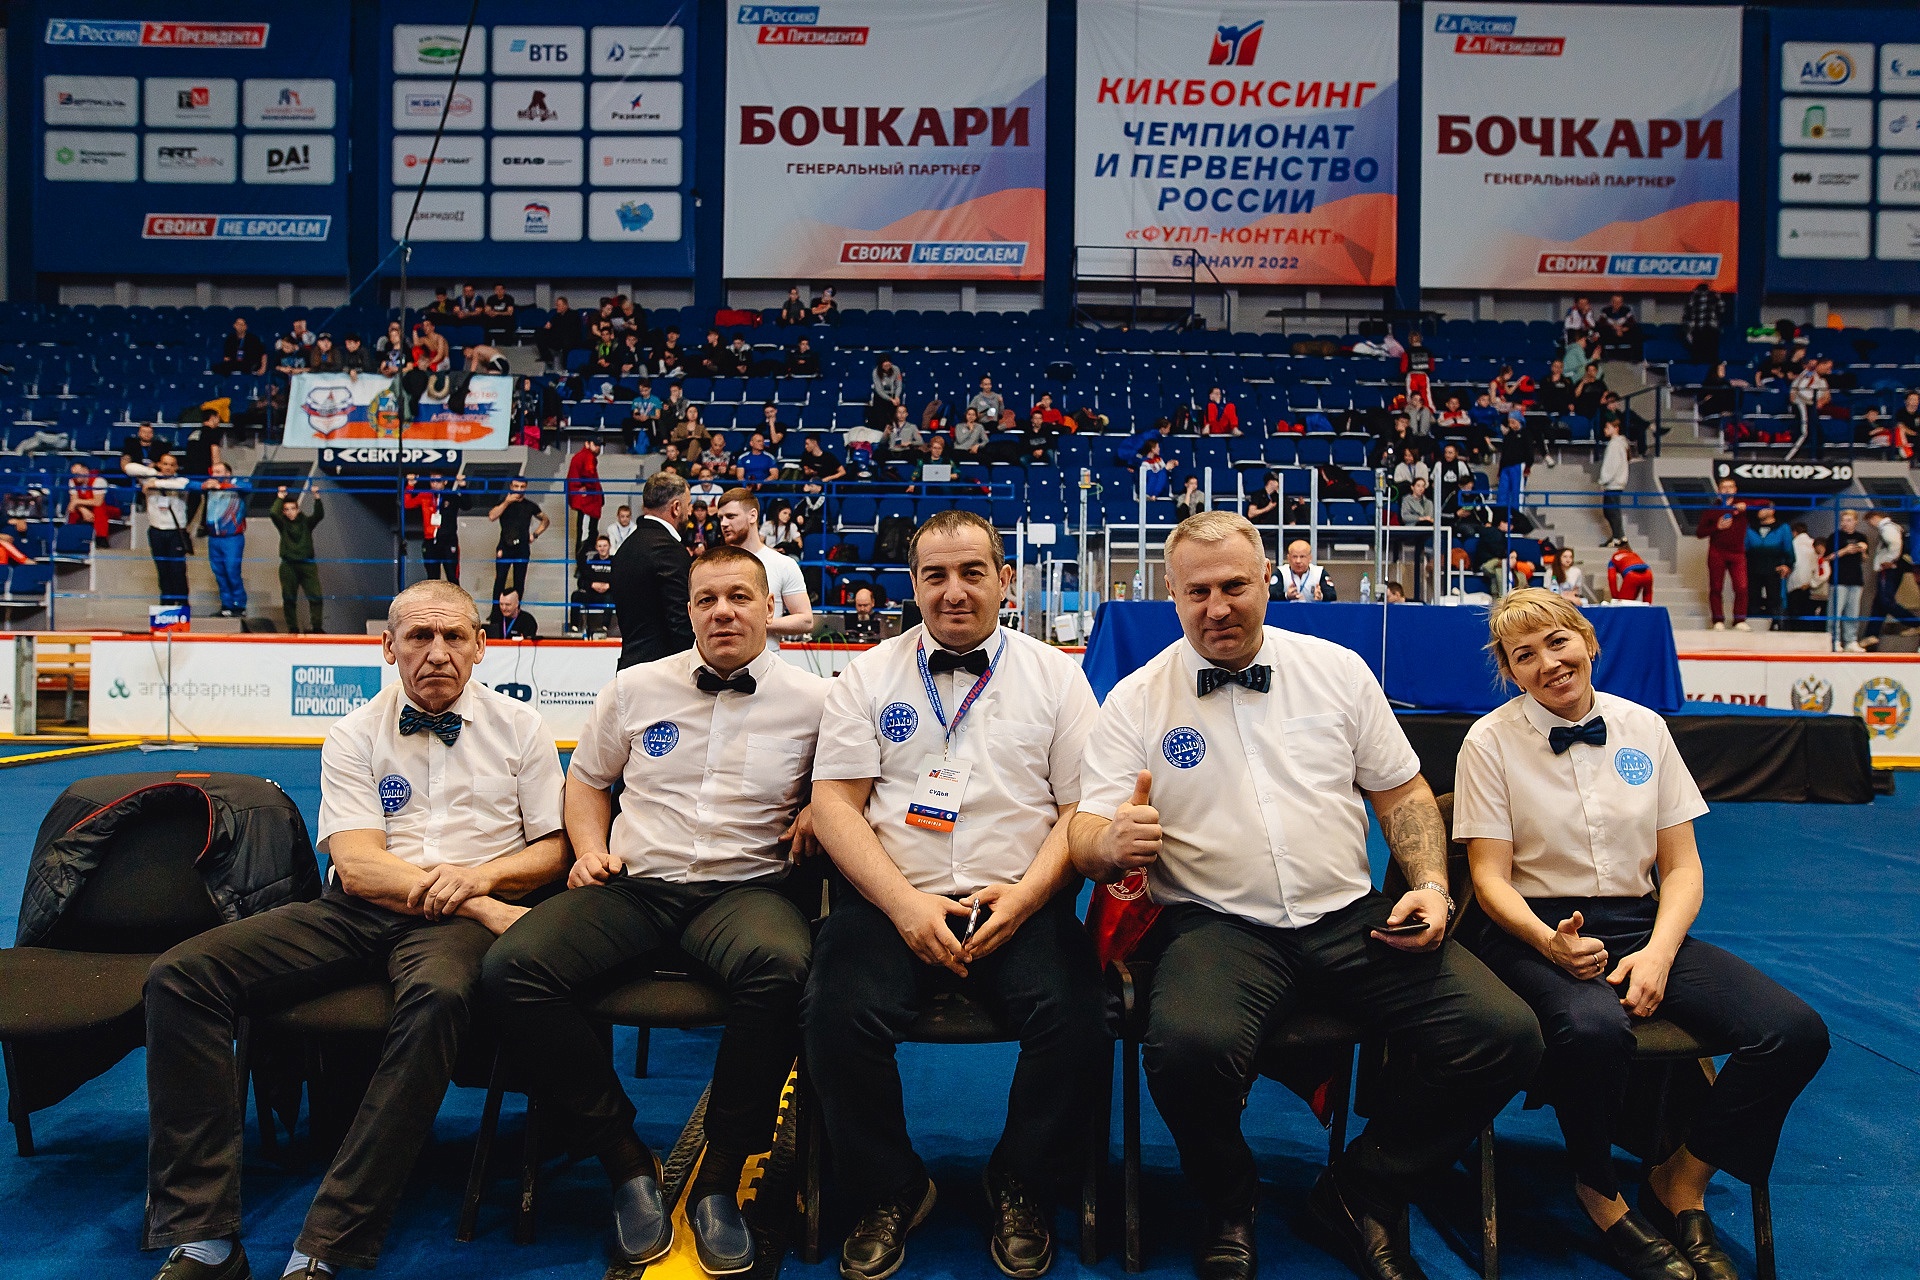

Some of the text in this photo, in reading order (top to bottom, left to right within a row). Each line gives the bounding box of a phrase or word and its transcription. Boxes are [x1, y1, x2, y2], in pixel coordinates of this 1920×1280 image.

[529, 44, 568, 62] ВТБ
[1097, 77, 1377, 108] КИКБОКСИНГ
[740, 105, 1030, 147] БОЧКАРИ
[1123, 121, 1354, 150] ЧЕМПИОНАТ
[1437, 114, 1724, 160] БОЧКАРИ
[267, 145, 310, 168] DA!
[786, 161, 981, 176] ГЕНЕРАЛЬНЫЙ ПАРТНЕР
[1095, 153, 1379, 183] И ПЕРВЕНСТВО
[1484, 172, 1676, 188] ГЕНЕРАЛЬНЫЙ ПАРТНЕР
[1158, 186, 1316, 215] РОССИИ
[153, 218, 321, 236] СВОИХ НЕ БРОСАЕМ
[1125, 225, 1346, 246] «ФУЛЛ-КОНТАКТ»
[848, 246, 1019, 262] СВОИХ НЕ БРОСАЕМ
[1172, 255, 1299, 270] БАРНАУЛ 2022
[1545, 256, 1713, 274] СВОИХ НЕ БРОСАЕМ
[323, 448, 457, 463] 8 СЕКТОР 9
[1718, 463, 1852, 480] 9 СЕКТОР 10
[294, 667, 335, 685] ФОНД
[295, 684, 363, 698] АЛЕКСАНДРА
[540, 689, 598, 698] Строитель
[950, 668, 992, 728] БАРНАУЛ 20
[294, 697, 369, 715] ПРОКОПЬЕ
[886, 717, 912, 728] WAKO
[1171, 740, 1199, 755] WAKO
[381, 789, 405, 799] WAKO
[928, 788, 949, 797] СУДЬЯ
